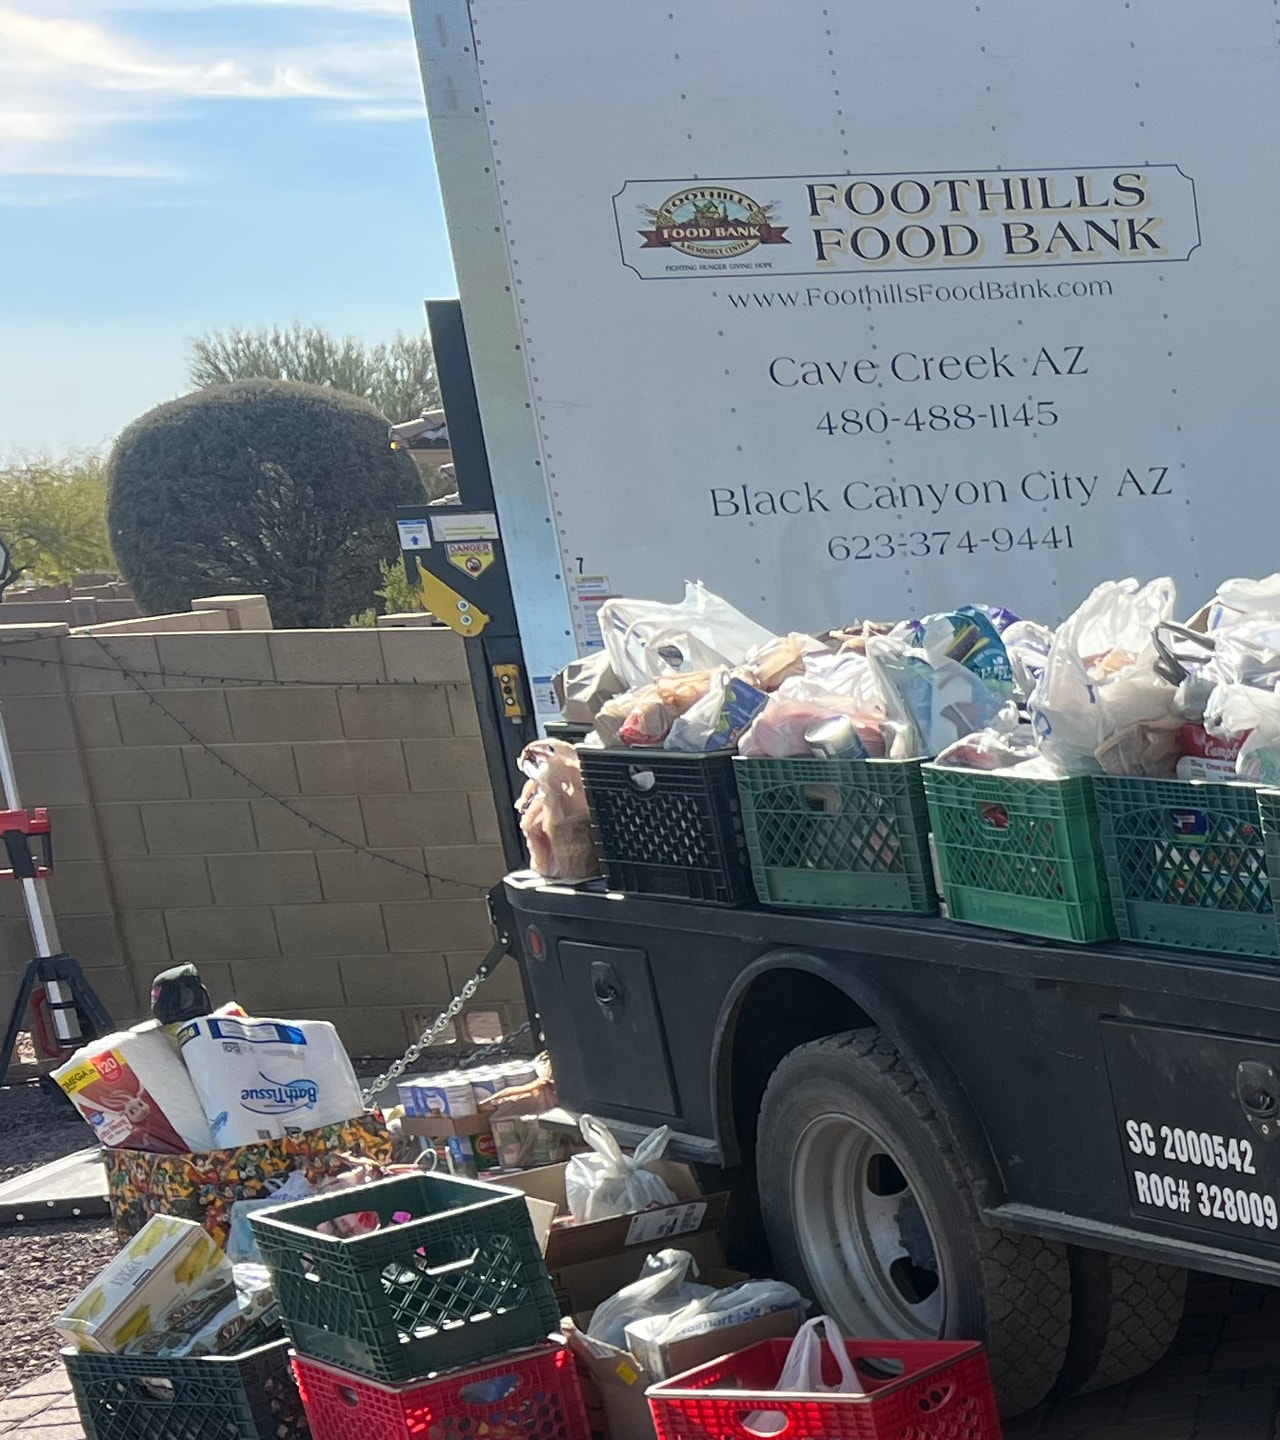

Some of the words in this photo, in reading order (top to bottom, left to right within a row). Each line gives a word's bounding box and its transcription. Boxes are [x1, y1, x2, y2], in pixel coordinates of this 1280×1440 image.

[664, 190, 756, 215] FOOTHILLS
[805, 172, 1147, 218] FOOTHILLS
[662, 227, 711, 239] FOOD
[714, 225, 761, 238] BANK
[811, 223, 980, 263] FOOD
[1001, 216, 1163, 258] BANK
[665, 264, 698, 272] FIGHTING
[699, 263, 728, 271] HUNGER
[729, 262, 752, 270] GIVING
[754, 261, 773, 270] HOPE
[727, 278, 1113, 309] www.FoothillsFoodBank.com
[768, 356, 878, 388] Cave
[890, 346, 1016, 384] Creek
[1030, 346, 1090, 377] AZ
[815, 401, 1059, 437] 480-488-1145
[709, 482, 830, 518] Black
[843, 476, 1008, 515] Canyon
[1020, 470, 1099, 508] City
[1116, 466, 1173, 498] AZ
[449, 543, 490, 554] DANGER
[827, 524, 1074, 562] 623-374-9441
[576, 557, 584, 574] 7
[97, 1057, 118, 1076] 120
[1125, 1119, 1157, 1158] SC
[1160, 1125, 1257, 1175] 2000542
[1134, 1170, 1191, 1213] ROC#
[1196, 1182, 1279, 1231] 328009
